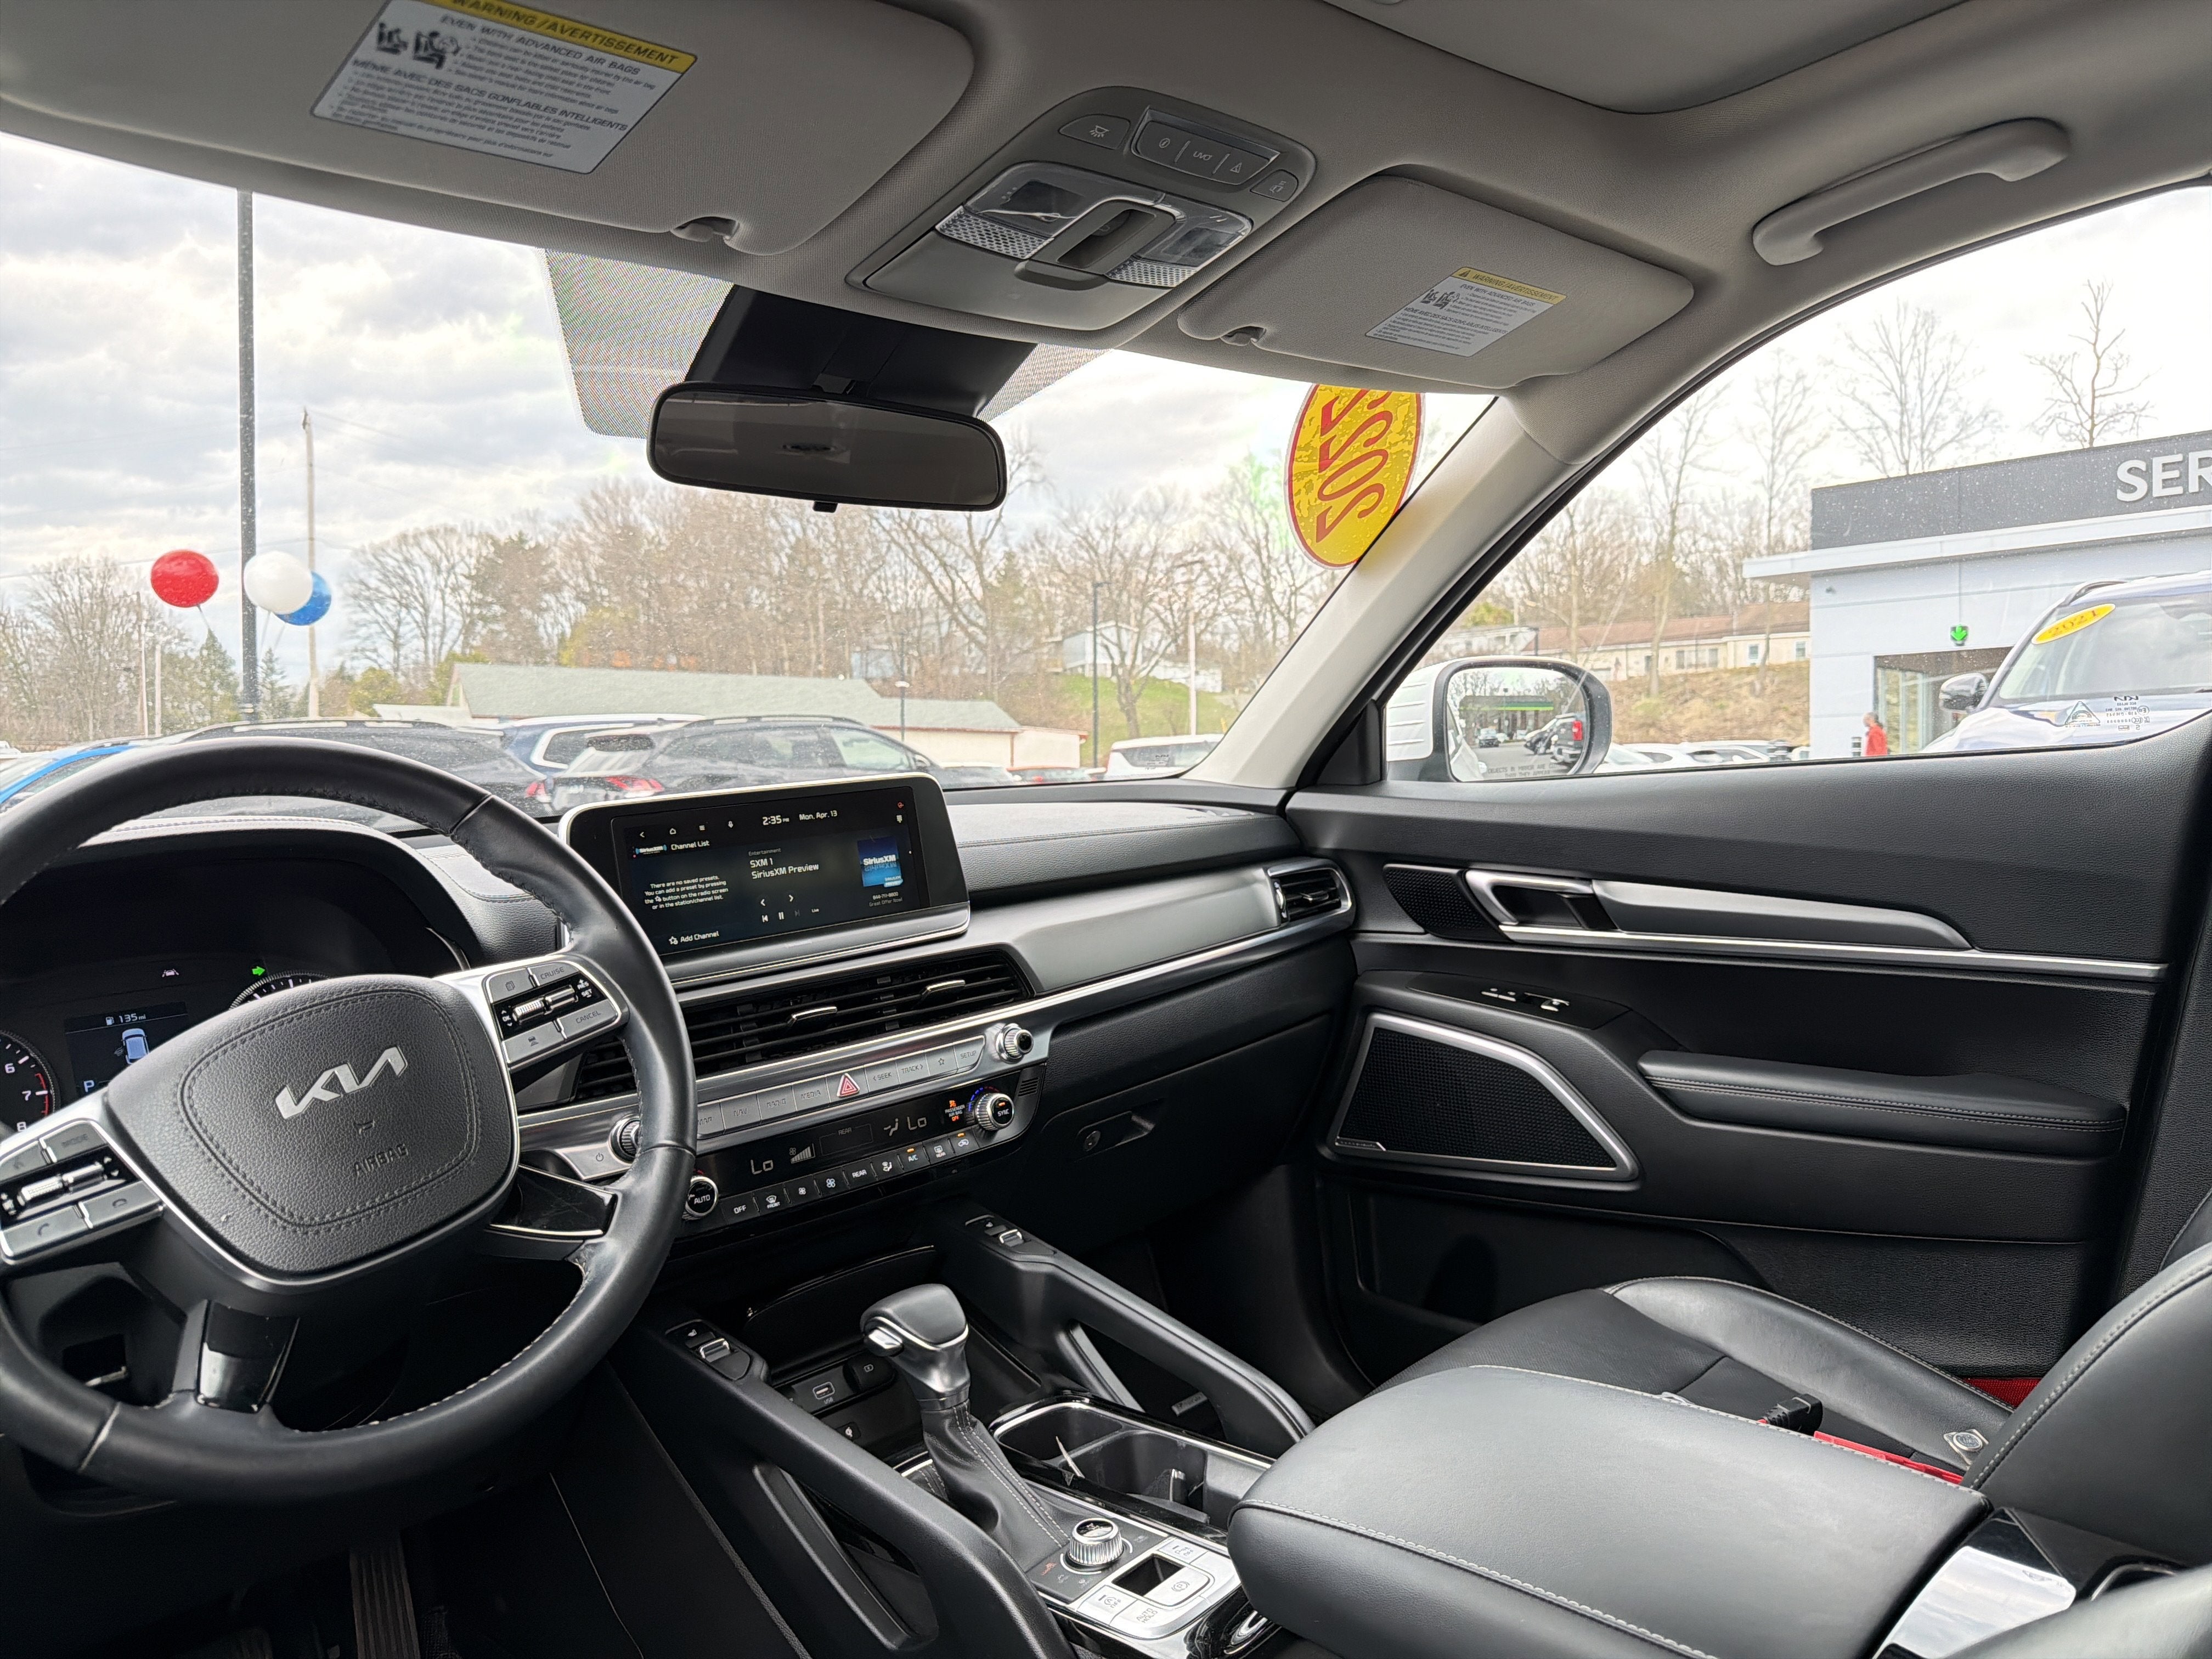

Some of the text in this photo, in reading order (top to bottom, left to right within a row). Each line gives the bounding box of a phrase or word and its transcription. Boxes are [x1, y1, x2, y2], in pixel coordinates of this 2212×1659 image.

[480, 25, 515, 41] WITH
[516, 36, 584, 60] ADVANCED
[585, 55, 607, 66] AIR
[609, 61, 642, 75] BAGS
[454, 83, 488, 97] SACS
[488, 92, 560, 115] GONFLABLES
[558, 109, 628, 131] INTELLIGENTS
[1472, 273, 1504, 286] WARNING
[2117, 449, 2212, 503] SER
[762, 815, 782, 826] 2:35
[670, 840, 697, 850] Channel
[748, 848, 782, 857] Entertainment
[750, 857, 774, 868] SXM 1
[863, 854, 896, 866] SiriusXM
[751, 863, 820, 880] SiriusXM Preview
[706, 880, 727, 889] pressing
[675, 896, 714, 907] station/channel
[680, 930, 720, 943] Add Channel
[540, 967, 565, 980] CRUISE
[577, 981, 590, 990] RES
[581, 989, 592, 997] SET
[119, 1013, 137, 1024] 135
[576, 1011, 601, 1024] CANCEL
[960, 1051, 977, 1059] SETUP
[4, 1063, 15, 1074] 6
[901, 1065, 919, 1074] TRACK
[877, 1072, 892, 1080] SEEK
[83, 1080, 95, 1093] P
[275, 1045, 408, 1120] KIA
[21, 1090, 32, 1101] 7
[800, 1090, 821, 1100] MEDIA
[766, 1098, 787, 1108] RADIO
[733, 1108, 748, 1117] NAV
[945, 1104, 966, 1114] PASSENGER
[997, 1108, 1010, 1117] SYNC
[16, 1121, 27, 1132] 8
[697, 1116, 713, 1126] MAP
[907, 1116, 927, 1131] Lo
[838, 1127, 853, 1136] REAR
[354, 1143, 409, 1176] AIRBAG
[750, 1159, 774, 1175] Lo
[851, 1169, 867, 1178] REAR
[693, 1194, 711, 1205] AUTO
[766, 1201, 781, 1209] FRONT
[733, 1204, 747, 1215] OFF
[1110, 1598, 1122, 1609] OFF
[1136, 1607, 1153, 1621] AUTO
[1142, 1610, 1159, 1624] HOLD
